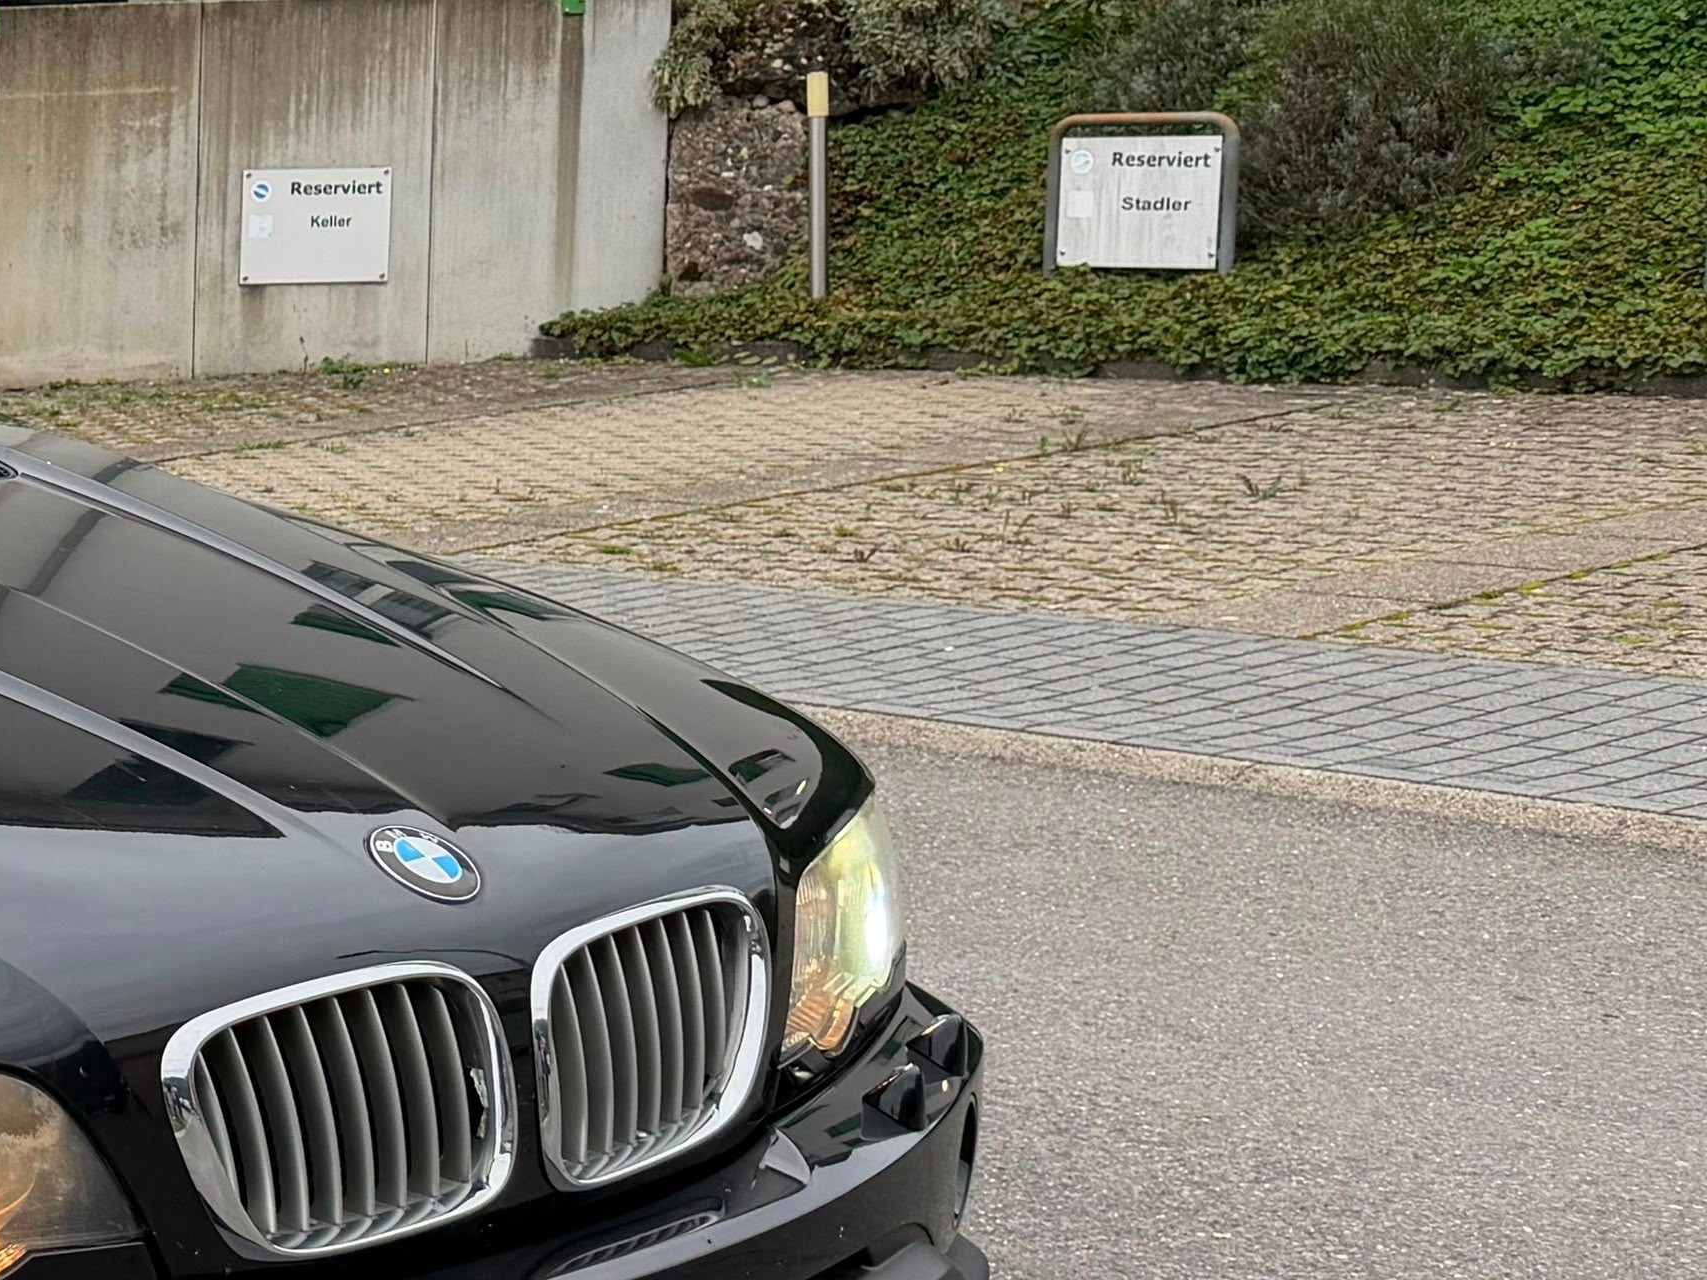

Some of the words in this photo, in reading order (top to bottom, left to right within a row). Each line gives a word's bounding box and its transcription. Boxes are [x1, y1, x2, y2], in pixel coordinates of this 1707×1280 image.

[1112, 151, 1211, 168] Reserviert
[290, 180, 383, 196] Reserviert
[1121, 196, 1192, 212] Stadler
[310, 215, 353, 228] Keller
[374, 828, 439, 854] BMW
